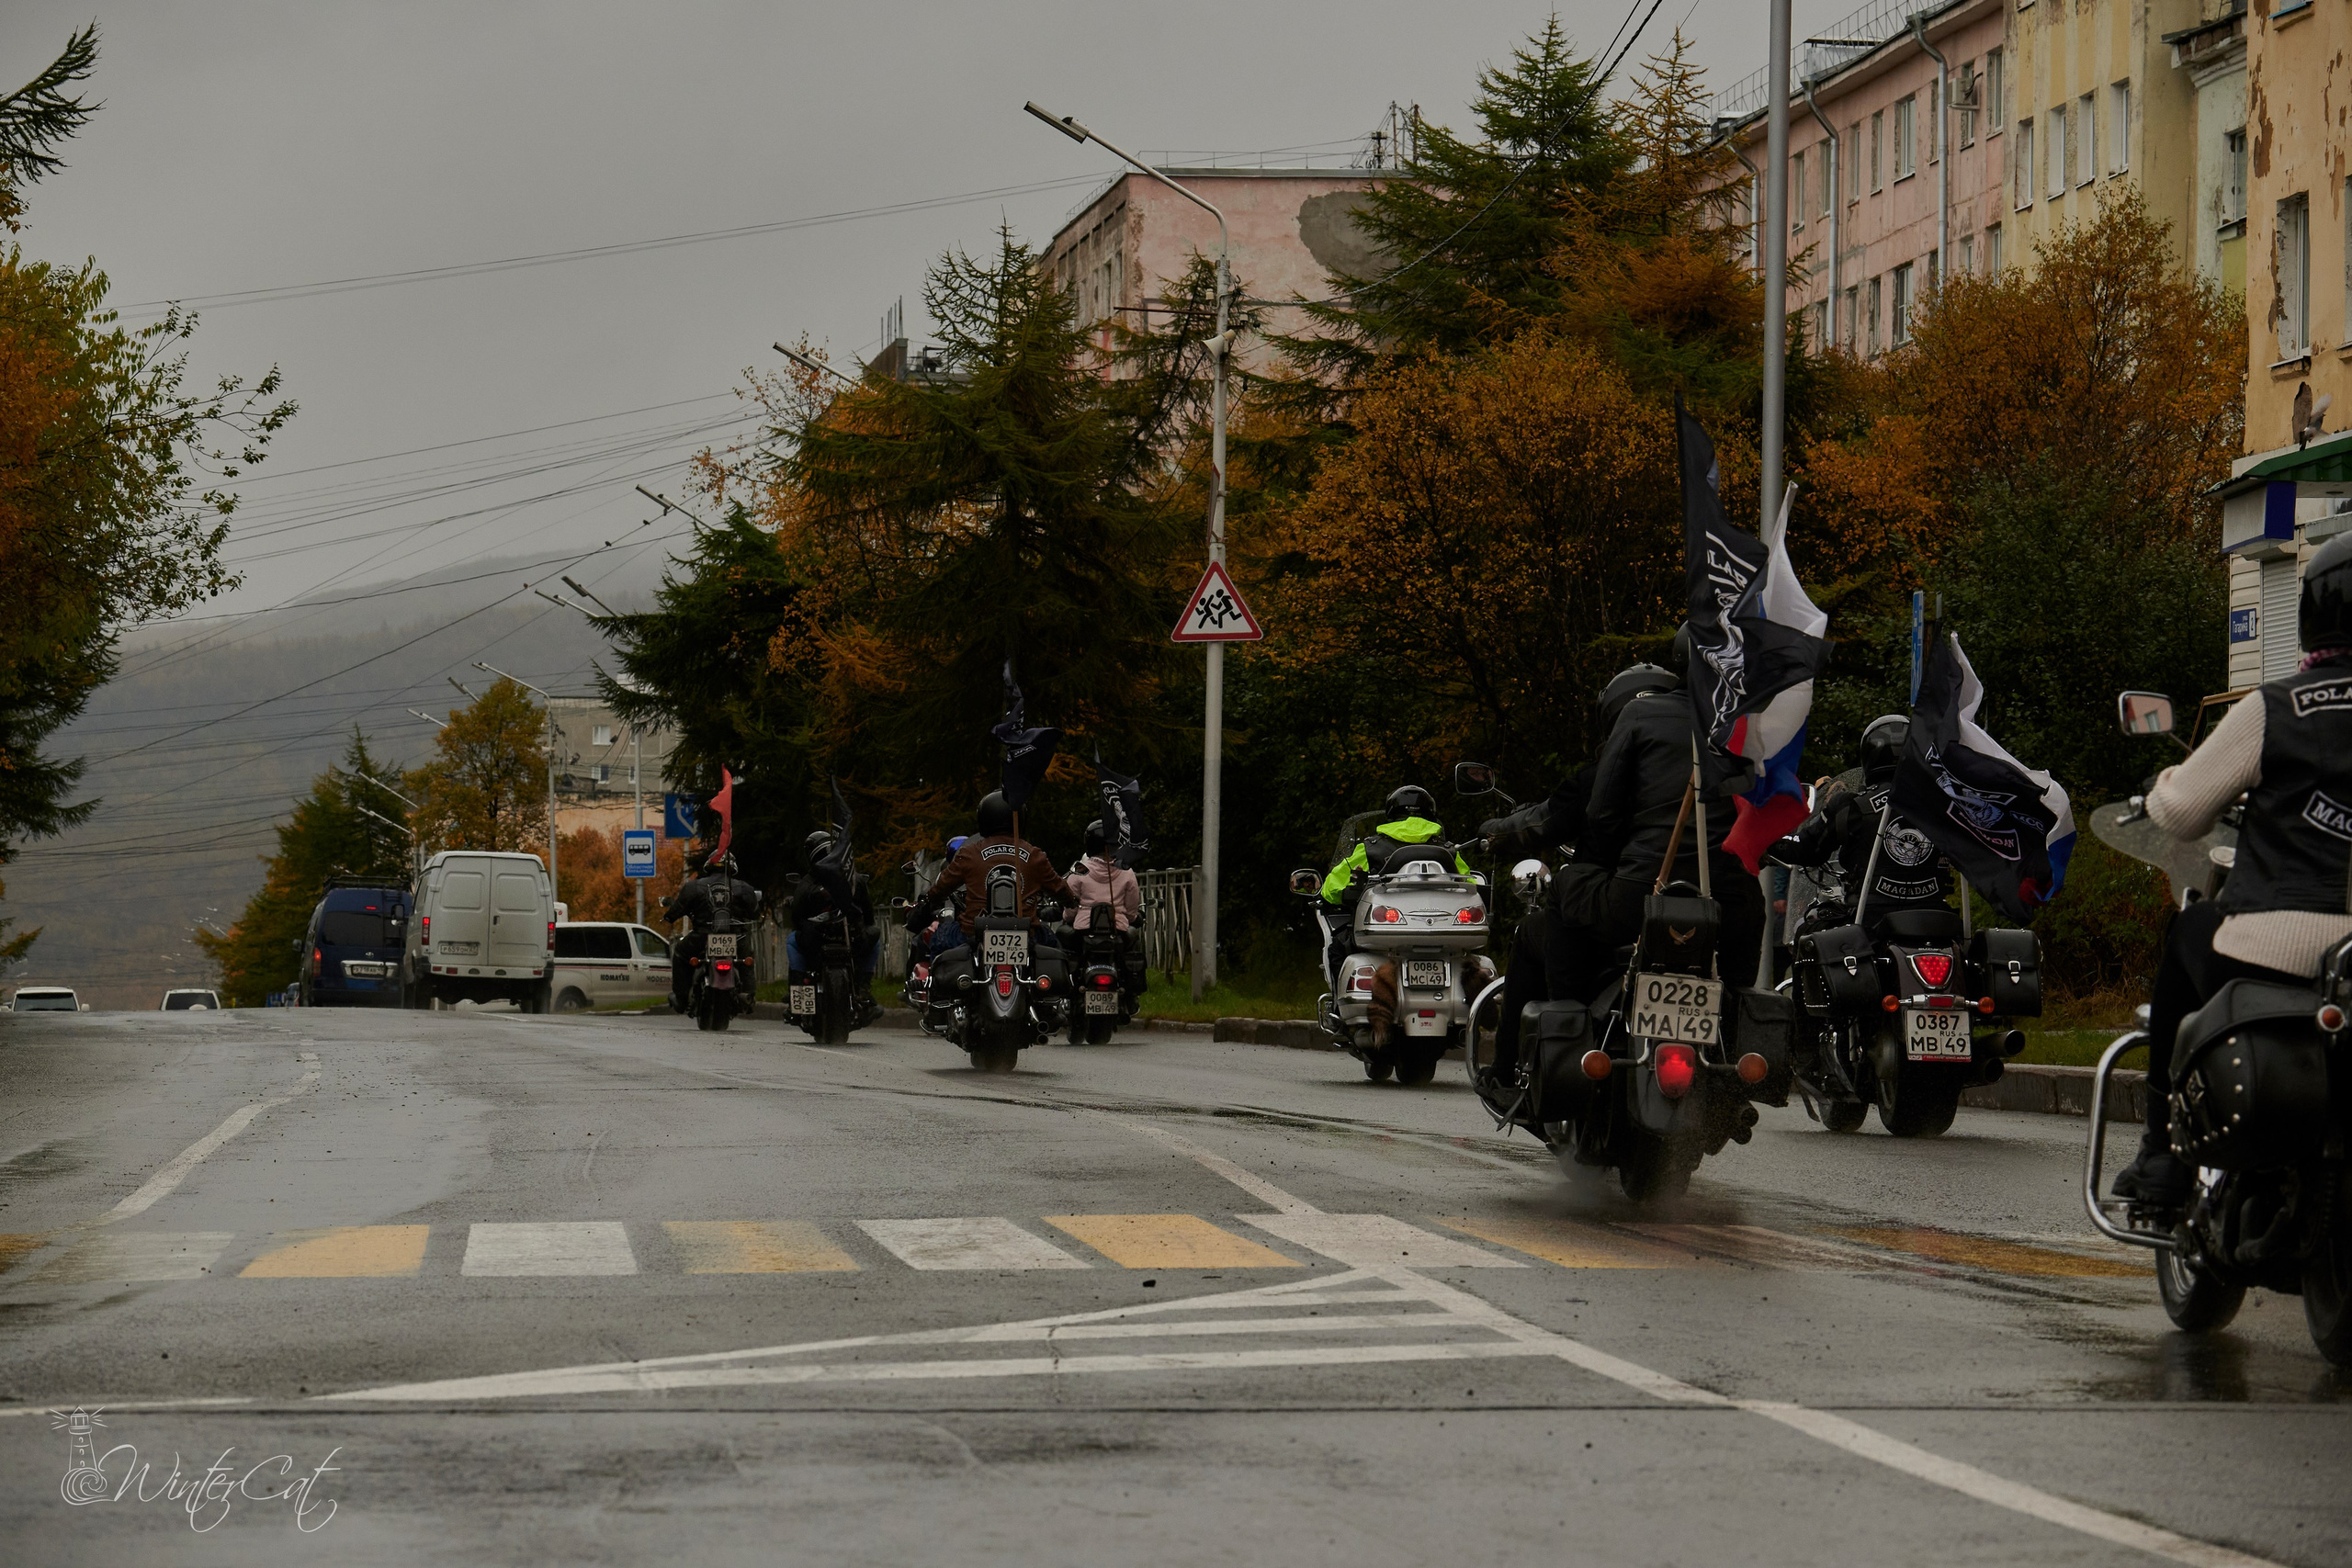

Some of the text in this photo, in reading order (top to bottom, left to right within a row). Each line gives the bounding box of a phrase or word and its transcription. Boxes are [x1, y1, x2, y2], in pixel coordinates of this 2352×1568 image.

[983, 846, 1028, 860] POLAR OLS
[1881, 882, 1936, 897] MAGADAN
[712, 936, 733, 945] 0169
[990, 935, 1022, 947] 0372
[725, 947, 735, 955] 49
[1010, 951, 1024, 963] 49
[1413, 962, 1439, 972] 0086
[600, 974, 630, 982] KOMATSU
[1430, 975, 1442, 985] 49
[804, 987, 814, 998] 49
[1091, 993, 1114, 1002] 0089
[1648, 980, 1708, 1008] 0228
[793, 990, 802, 1010] 0337
[1104, 1005, 1116, 1013] 49
[1679, 1007, 1701, 1017] RUS
[1917, 1014, 1960, 1030] 0387
[1683, 1017, 1713, 1040] 49
[1945, 1037, 1967, 1053] 49
